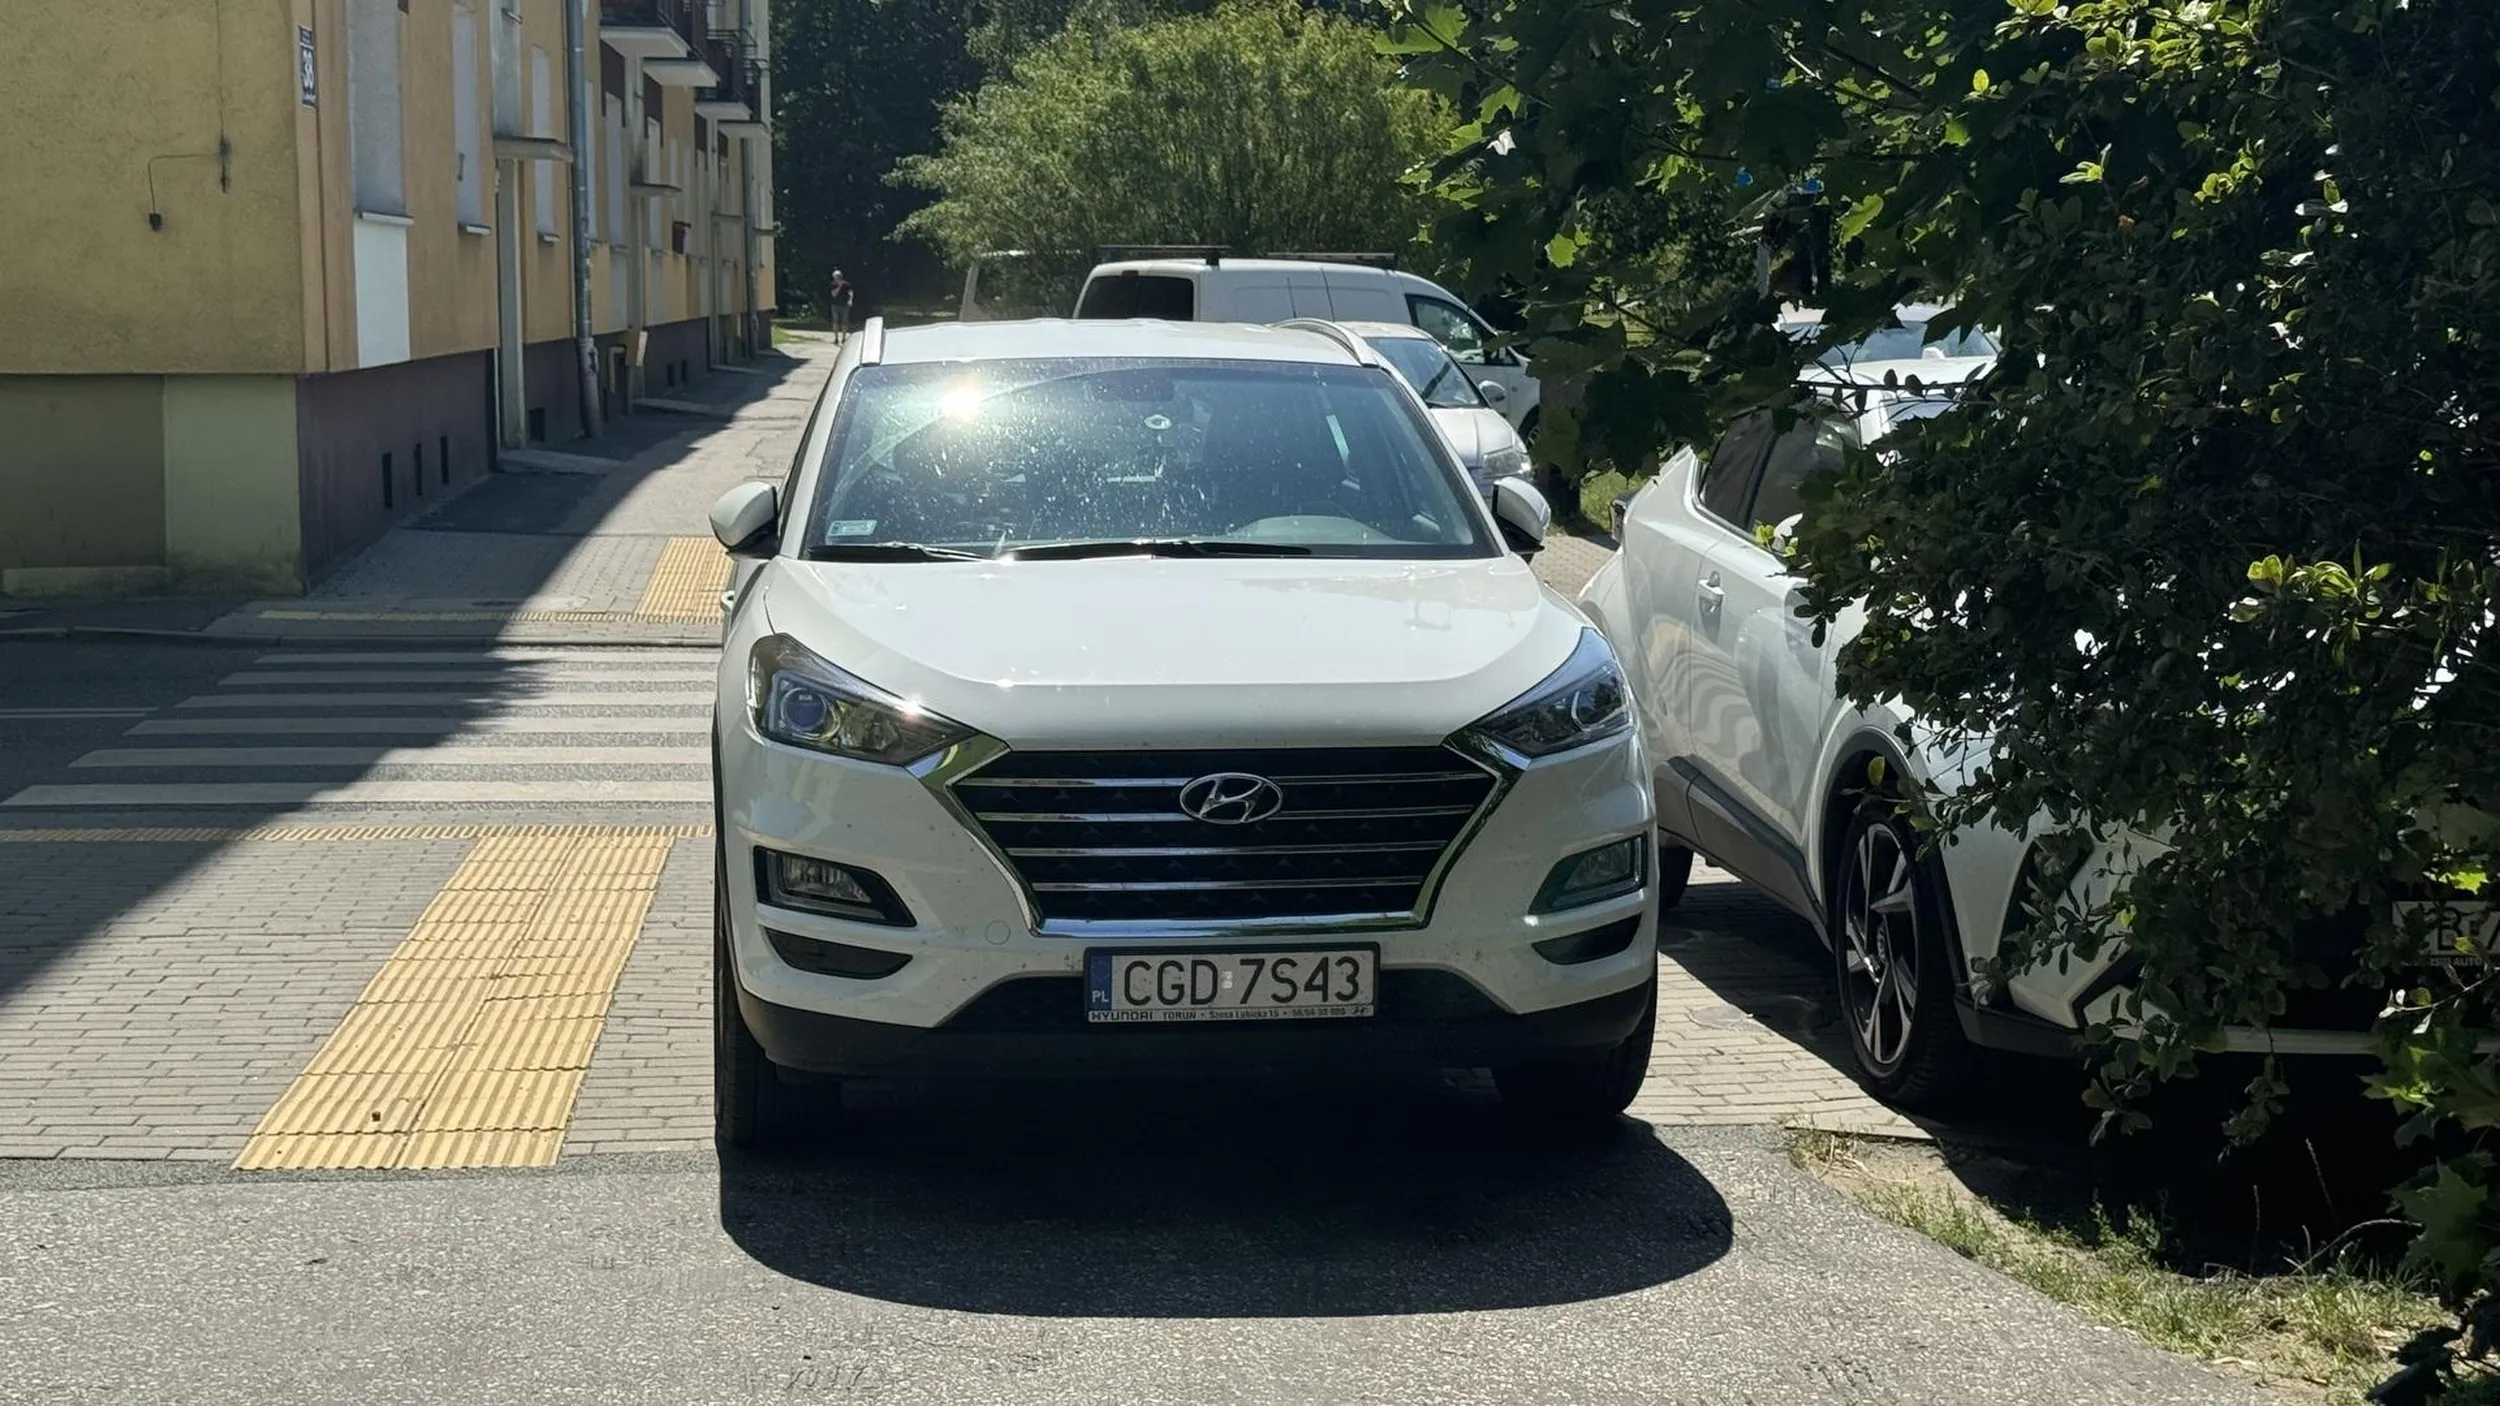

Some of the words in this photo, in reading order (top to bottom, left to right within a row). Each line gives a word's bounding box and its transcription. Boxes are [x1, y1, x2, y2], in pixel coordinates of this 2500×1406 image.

[1124, 959, 1219, 1006] CGD
[1239, 956, 1360, 1005] 7S43
[1092, 991, 1109, 1003] PL
[1091, 1010, 1153, 1021] HYUNDAI
